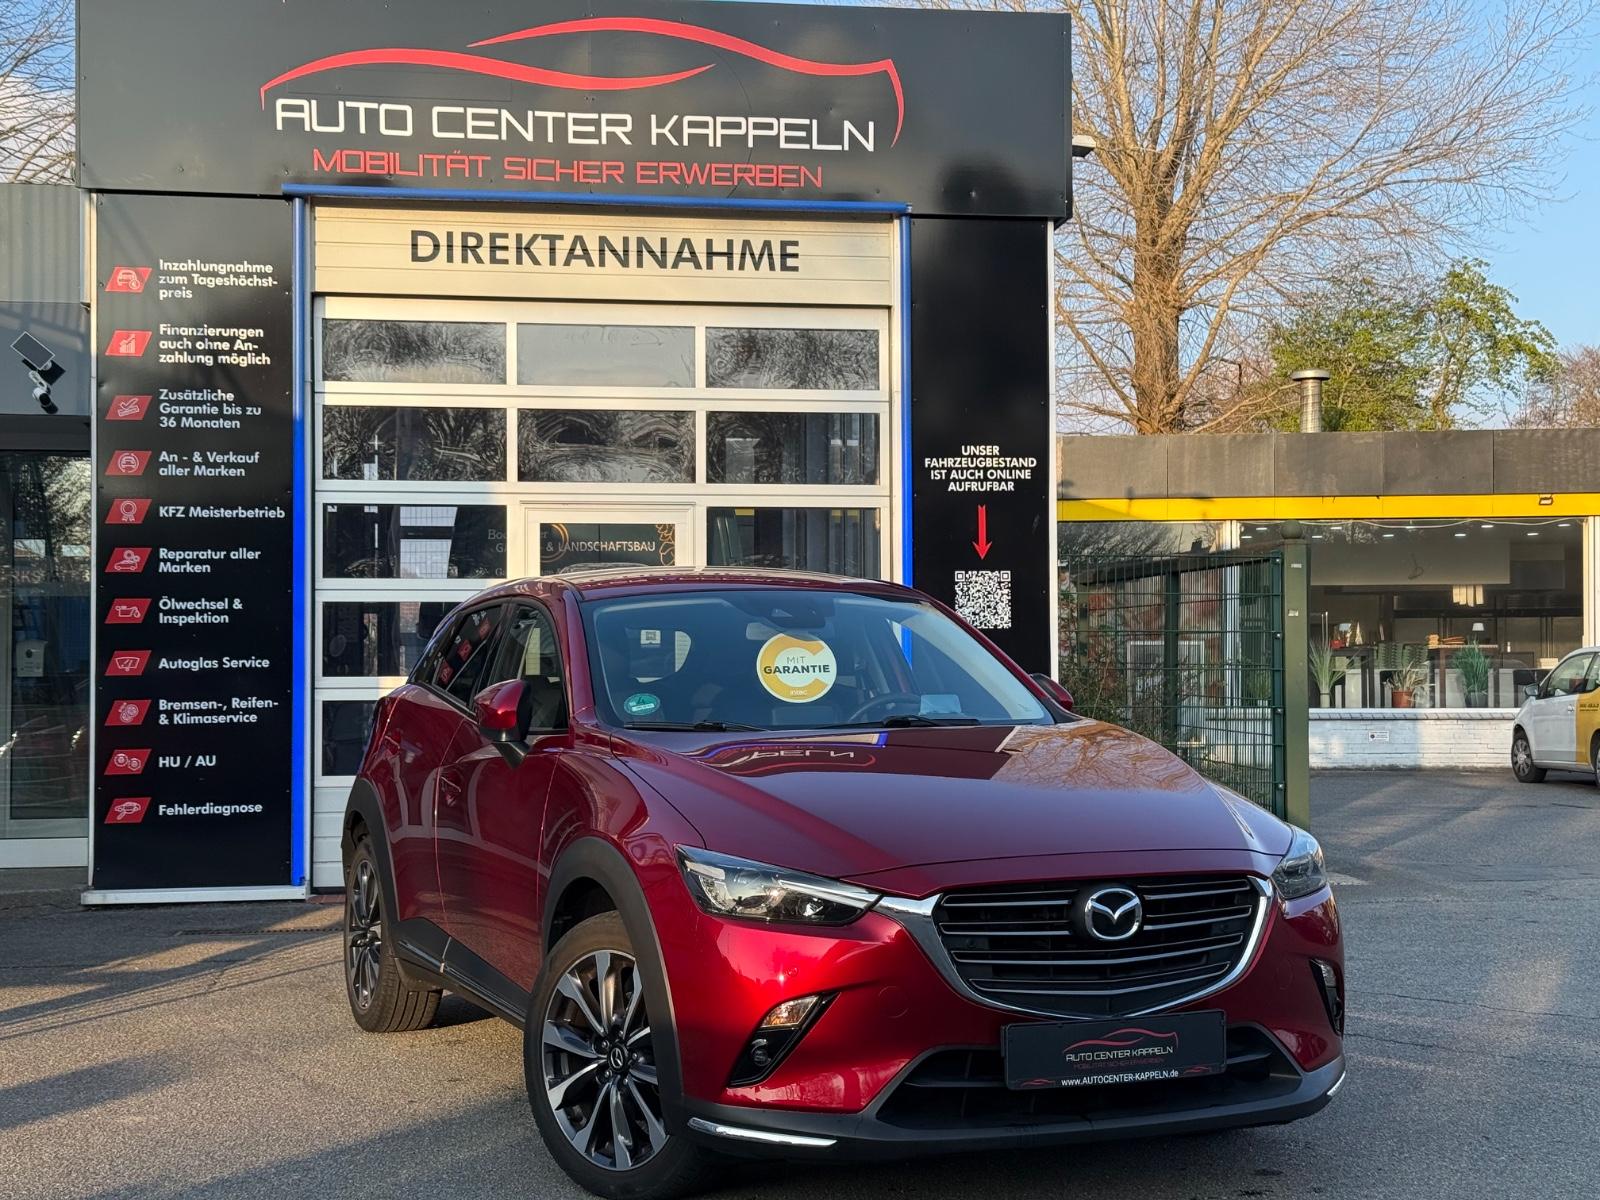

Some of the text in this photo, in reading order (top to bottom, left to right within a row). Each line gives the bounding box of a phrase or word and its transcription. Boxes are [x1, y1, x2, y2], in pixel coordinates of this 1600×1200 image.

[275, 98, 875, 152] AUTO CENTER KAPPELN
[312, 148, 823, 189] MOBILITÄT SICHER ERWERBEN
[410, 229, 799, 272] DIREKTANNAHME
[159, 259, 274, 275] Inzahlungnahme
[158, 273, 278, 288] zum Tageshöchst-
[159, 286, 193, 301] preis
[159, 324, 264, 340] Finanzierungen
[158, 337, 259, 351] auch ohne An-
[158, 352, 271, 368] zahlung möglich
[159, 388, 235, 402] Zusätzliche
[159, 402, 262, 416] Garantie bis zu
[159, 416, 241, 429] 36 Monaten
[192, 451, 203, 463] &
[206, 451, 260, 464] Verkauf
[961, 445, 1000, 456] UNSER
[924, 456, 1037, 468] FAHRZEUGBESTAND
[158, 463, 246, 477] aller Marken
[930, 469, 1032, 480] IST AUCH ONLINE
[947, 481, 1015, 492] AUFRUFBAR
[159, 505, 286, 519] KFZ Meisterbetrieb
[545, 539, 656, 552] & LANDSCHAFTSBAU
[159, 547, 262, 562] Reparatur aller
[158, 561, 211, 573] Marken
[158, 595, 243, 610] Ölwechsel &
[159, 611, 229, 627] Inspektion
[158, 655, 270, 672] Autoglas Service
[786, 656, 806, 665] MIT
[763, 664, 831, 675] GARANTIE
[158, 696, 279, 711] Bremsen-, Reifen-
[158, 711, 258, 725] & Klimaservice
[158, 755, 181, 768] HU
[194, 754, 217, 767] AU
[158, 802, 263, 817] Fehlerdiagnose
[1065, 1046, 1174, 1062] AUTO CENTER KAPPELN
[1061, 1069, 1179, 1086] www.AUTOCENTER-KAPPELN.de
